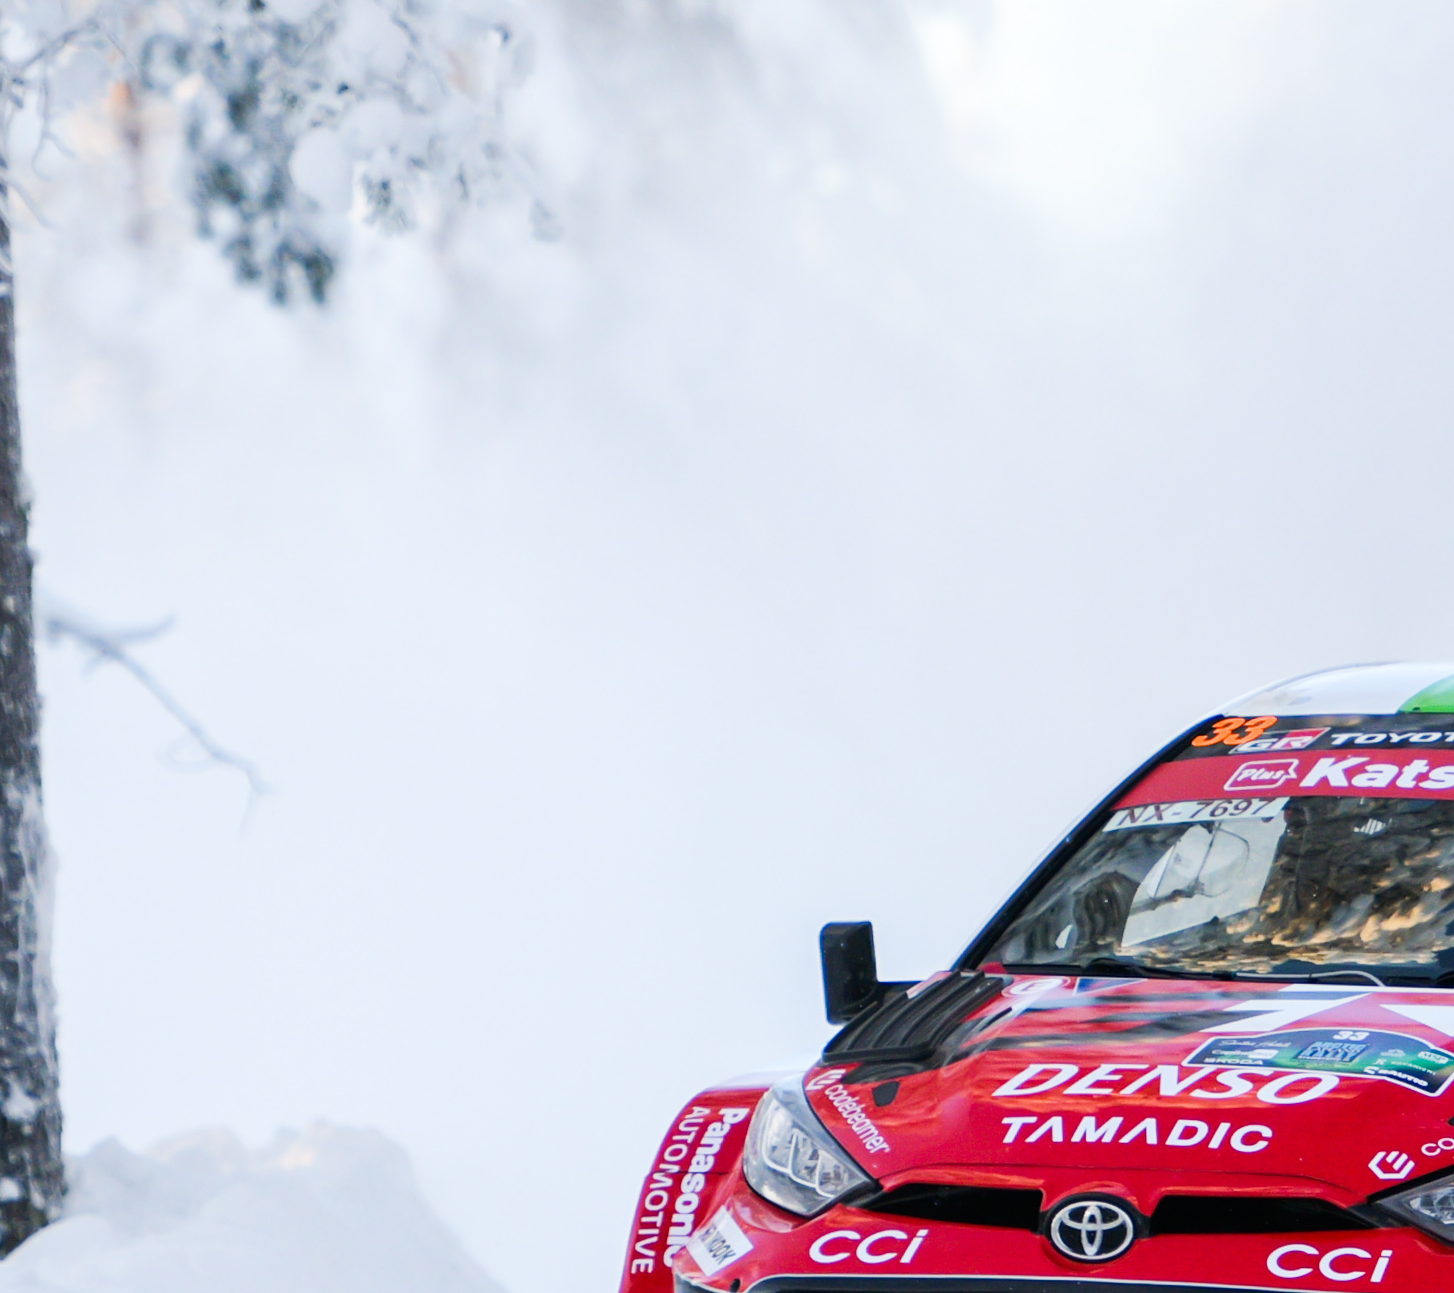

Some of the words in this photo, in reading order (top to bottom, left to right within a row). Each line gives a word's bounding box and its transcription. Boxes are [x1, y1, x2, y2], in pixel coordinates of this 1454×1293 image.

[1191, 715, 1279, 747] 33
[1236, 767, 1286, 782] Plus
[1332, 1030, 1370, 1042] 33
[992, 1063, 1341, 1105] DENSO
[824, 1082, 891, 1155] codebeamer
[1001, 1115, 1273, 1153] TAMADIC
[630, 1105, 712, 1275] AUTOMOTIVE
[662, 1107, 751, 1269] Panasonic
